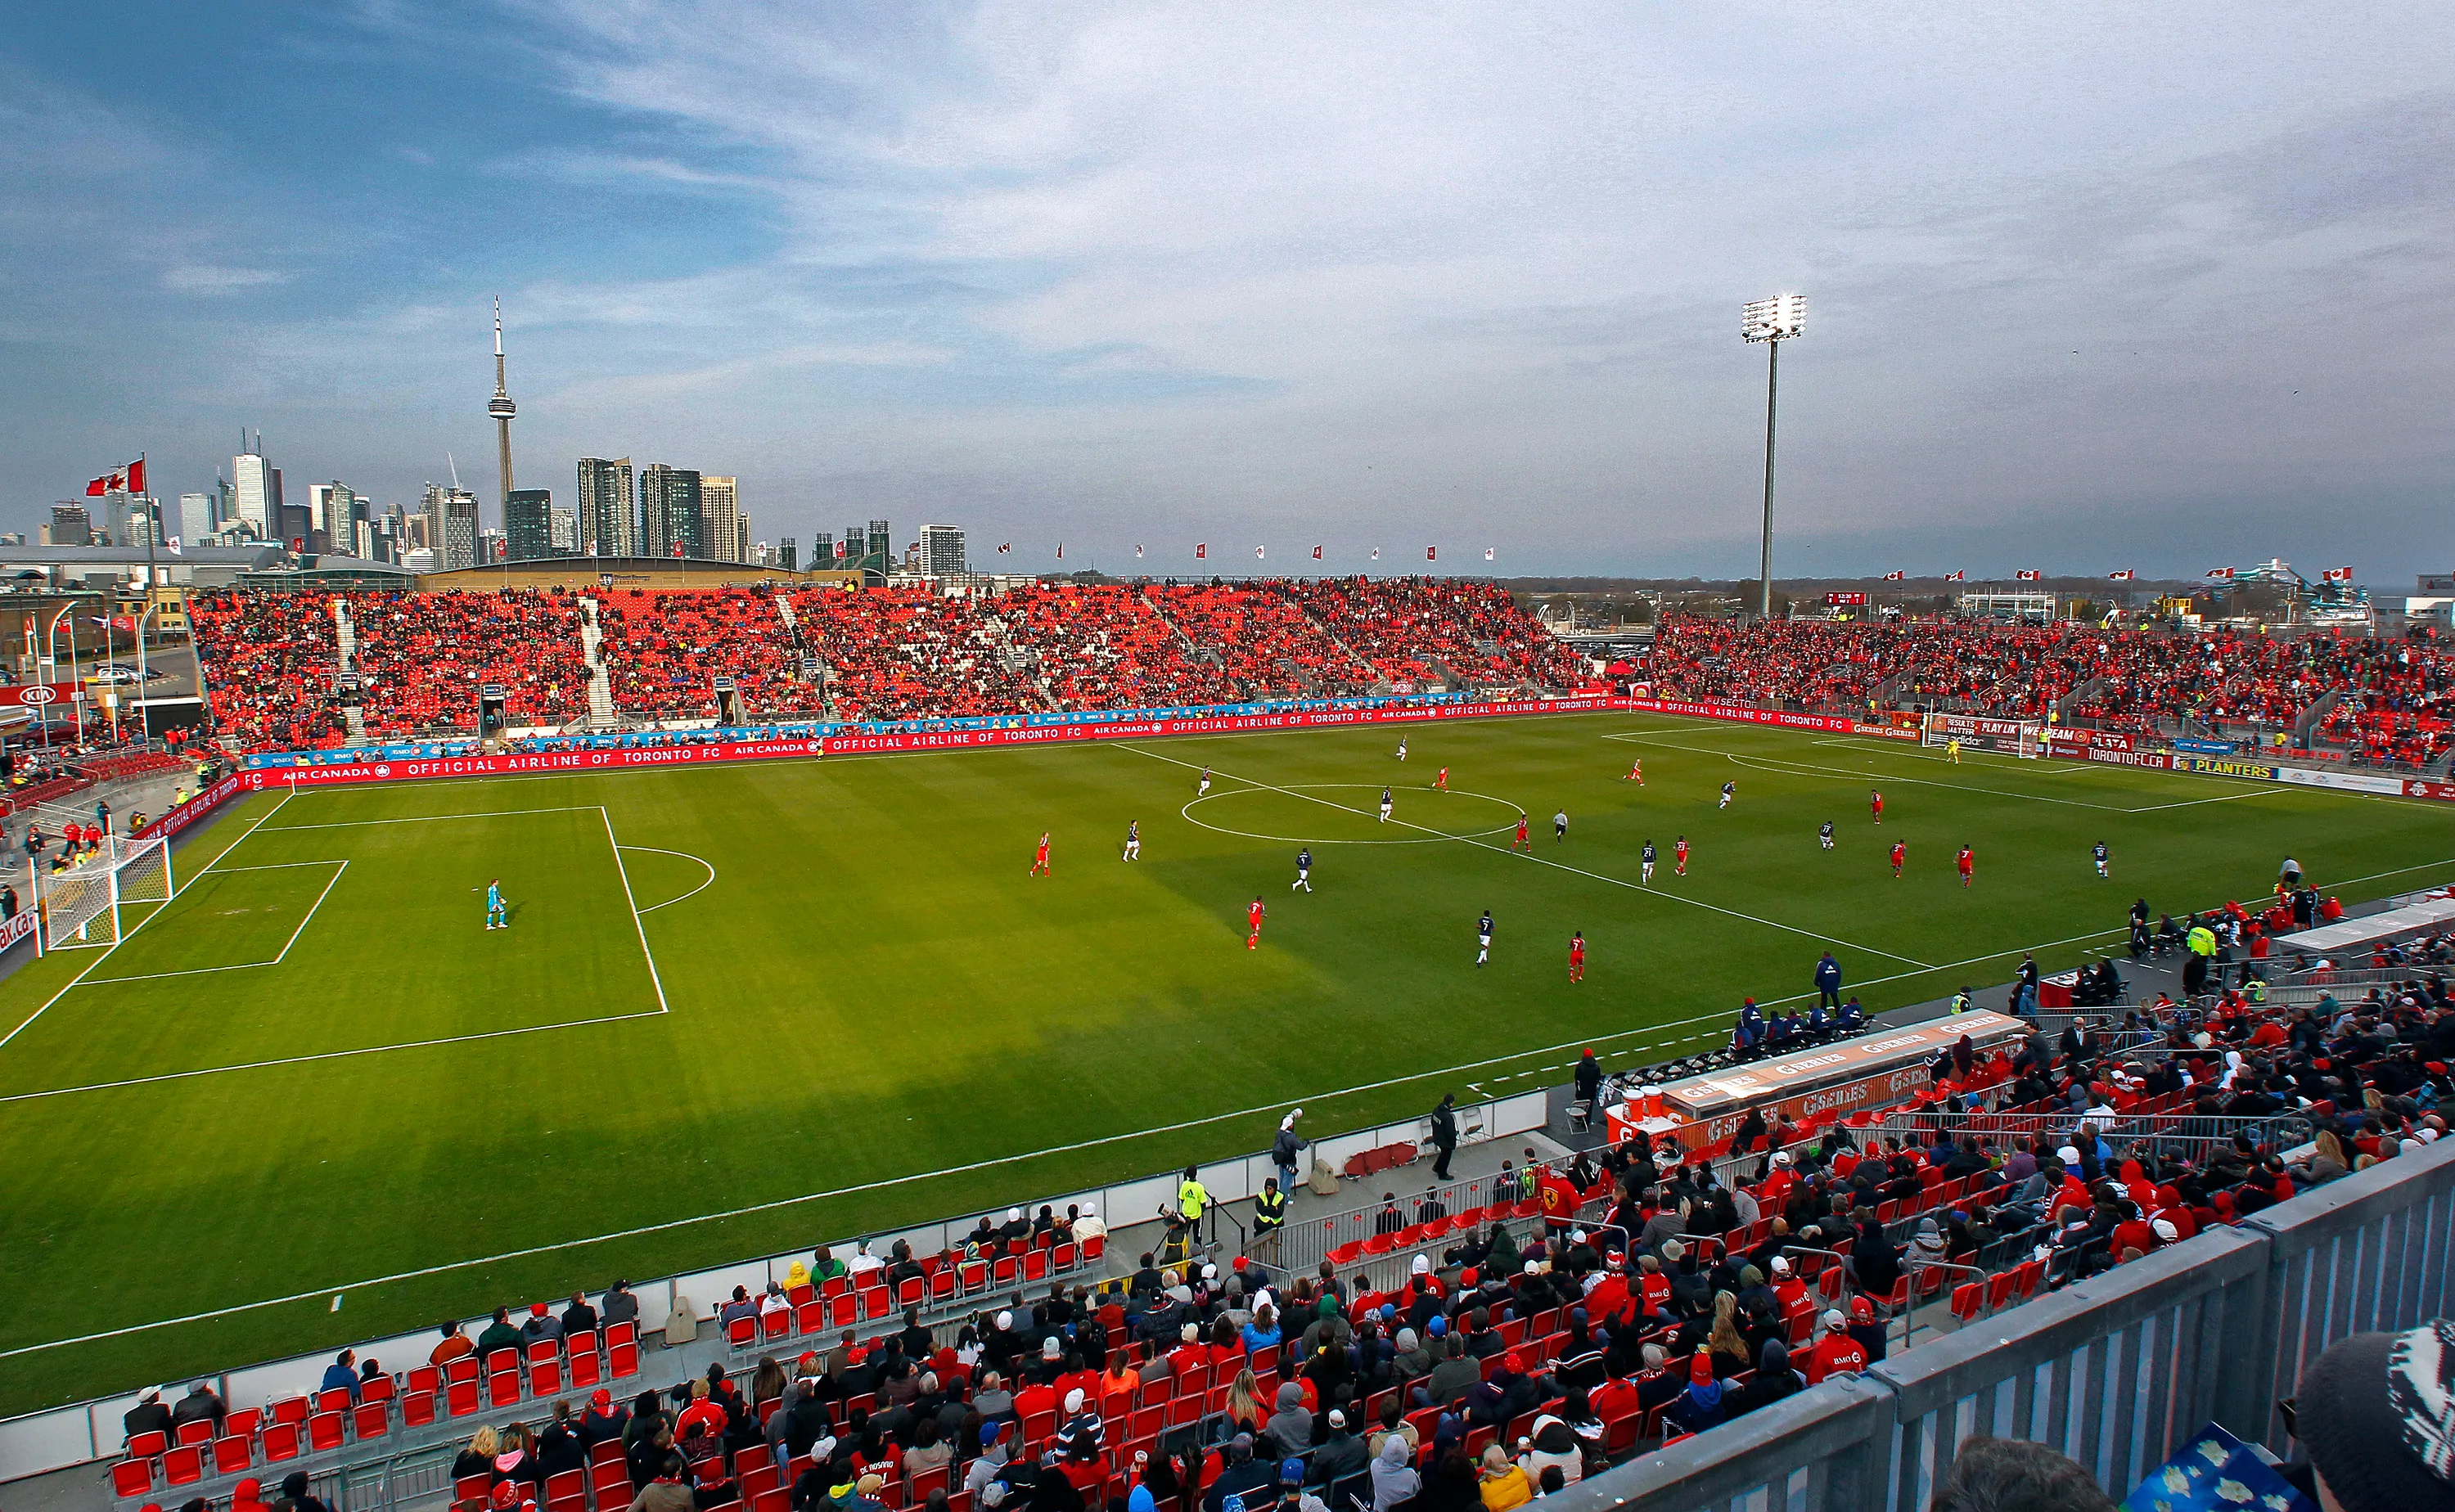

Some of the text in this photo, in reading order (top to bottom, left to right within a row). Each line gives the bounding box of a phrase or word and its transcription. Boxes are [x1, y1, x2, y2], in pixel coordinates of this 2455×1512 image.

[26, 691, 51, 701] KIA
[1444, 704, 1490, 716] OFFICIAL
[1496, 703, 1534, 713] AIRLINE
[1538, 702, 1550, 710] OF
[1556, 700, 1592, 710] TORONTO
[1597, 699, 1606, 707] FC
[1628, 700, 1654, 708] CANADA
[1667, 702, 1843, 729] OFFICIAL AIRLINE OF TORONTO FC
[1173, 709, 1426, 731] OFFICIAL AIRLINE OF TORONTO FC AIR CANADA
[1947, 718, 1975, 727] RESULTS
[833, 725, 1149, 750] OFFICIAL AIRLINE OF TORONTO FC AIR CANADA
[1947, 726, 1975, 735] MATTER
[1981, 722, 2002, 733] PLAY
[2024, 725, 2039, 736] WE
[408, 744, 804, 776] OFFICIAL AIRLINE OF TORONTO FC AIR CANADA
[2088, 746, 2164, 768] TORONTOFC.CA
[245, 767, 371, 785] FC AIR CANADA
[2195, 758, 2271, 778] PLANTERS
[164, 810, 190, 834] OFFICIAL
[191, 794, 211, 818] AIRLINE
[218, 776, 238, 797] TORONTO
[1775, 1052, 1847, 1075] GSERIES
[1619, 1127, 1633, 1142] G
[1791, 1298, 1805, 1308] BMO
[1833, 1355, 1852, 1366] BMO
[859, 1465, 868, 1475] DE
